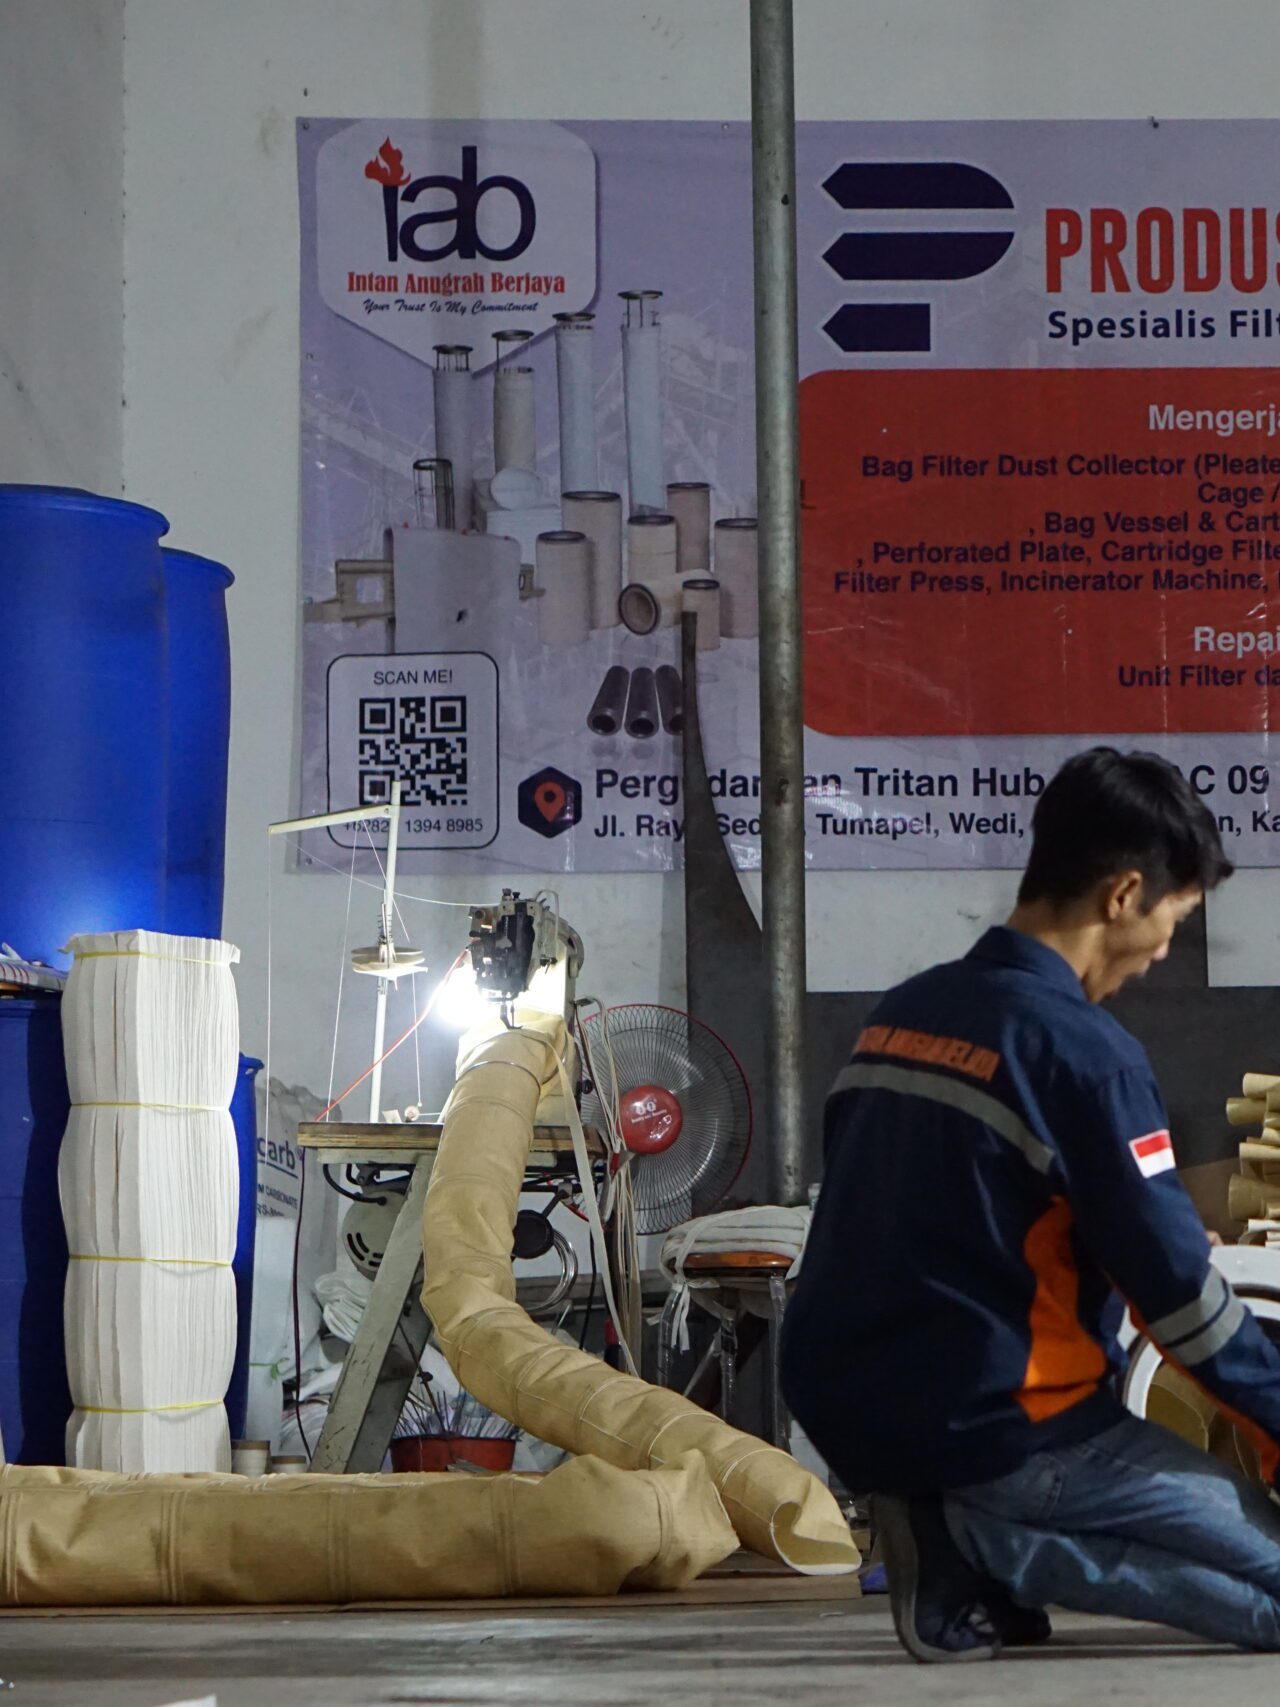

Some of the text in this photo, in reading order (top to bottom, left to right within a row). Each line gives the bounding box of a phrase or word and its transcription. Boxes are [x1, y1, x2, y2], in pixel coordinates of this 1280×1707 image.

[346, 271, 566, 297] Intan Anugrah Berjaya
[362, 298, 539, 316] Your Trust Is My Commitment
[1047, 309, 1217, 346] Spesialis
[862, 456, 914, 483] Bag
[922, 456, 989, 477] Filter
[996, 455, 1058, 476] Dust
[1066, 454, 1185, 476] Collector
[1197, 483, 1266, 509] Cage
[1044, 512, 1096, 539] Bag
[1103, 512, 1189, 533] Vessel
[1198, 511, 1217, 533] &
[872, 541, 1011, 564] Perforated
[1020, 540, 1094, 566] Plate,
[1101, 540, 1224, 567] Cartridge
[833, 572, 903, 594] Filter
[910, 571, 993, 597] Press,
[1000, 570, 1144, 593] Incinerator
[1152, 569, 1269, 594] Machine,
[372, 669, 454, 687] SCAN ME!
[1118, 666, 1170, 688] Unit
[1180, 665, 1246, 687] Filter
[853, 767, 959, 798] Tritan
[972, 766, 1045, 797] Hub
[1227, 763, 1270, 796] 09
[405, 818, 442, 833] 1394
[446, 817, 484, 832] 8985
[594, 815, 626, 838] Jl.
[636, 814, 686, 843] Ray
[815, 813, 940, 840] Tumapel,
[949, 812, 1025, 838] Wedi,
